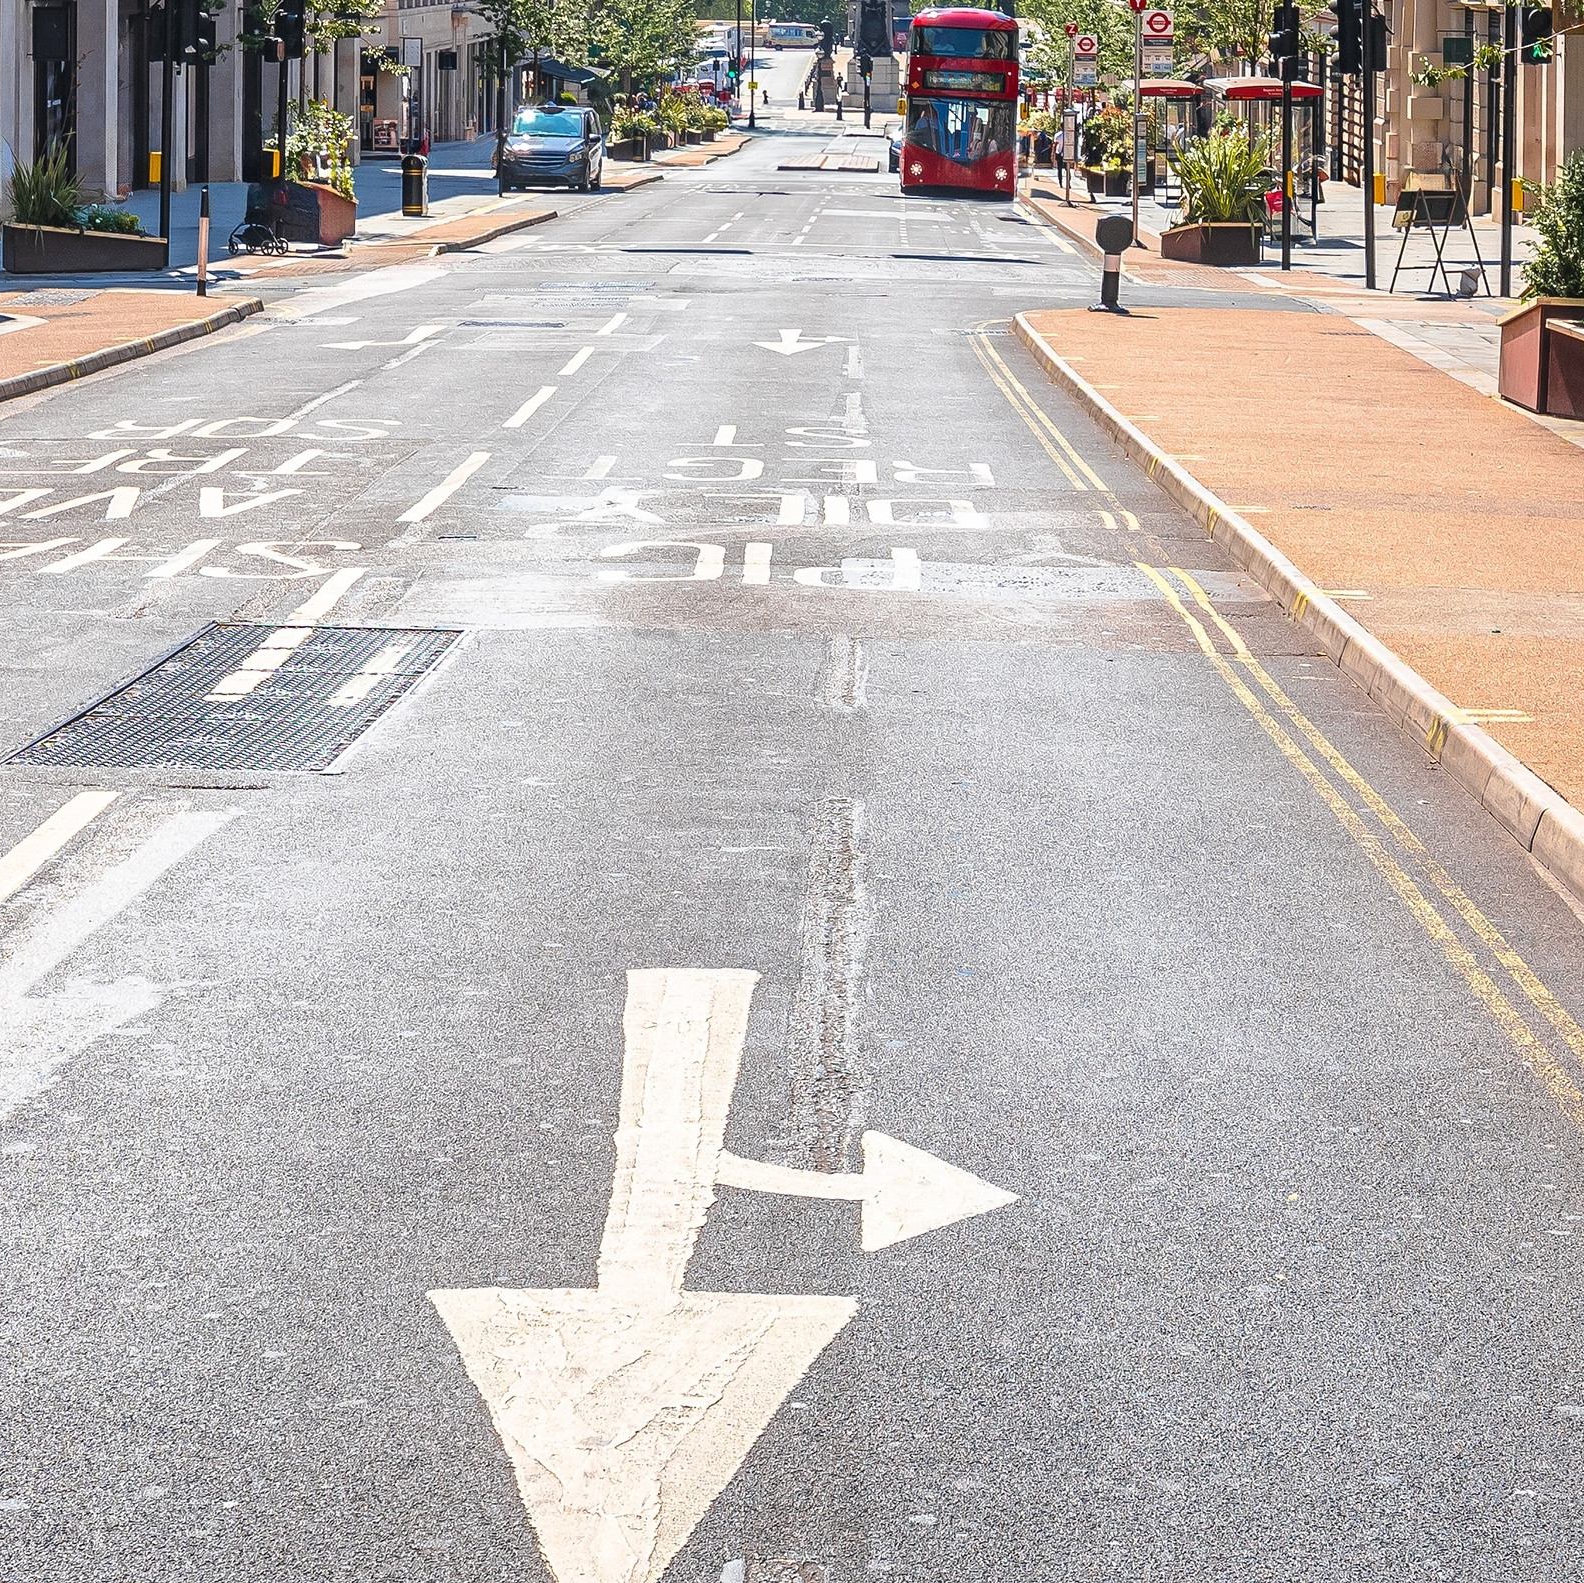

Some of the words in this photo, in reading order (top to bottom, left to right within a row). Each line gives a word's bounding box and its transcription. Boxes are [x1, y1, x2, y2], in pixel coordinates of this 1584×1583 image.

[1068, 24, 1076, 34] Z
[85, 417, 403, 440] SQR
[675, 424, 873, 449] ST
[542, 455, 995, 486] REGT
[597, 541, 922, 592] PIC
